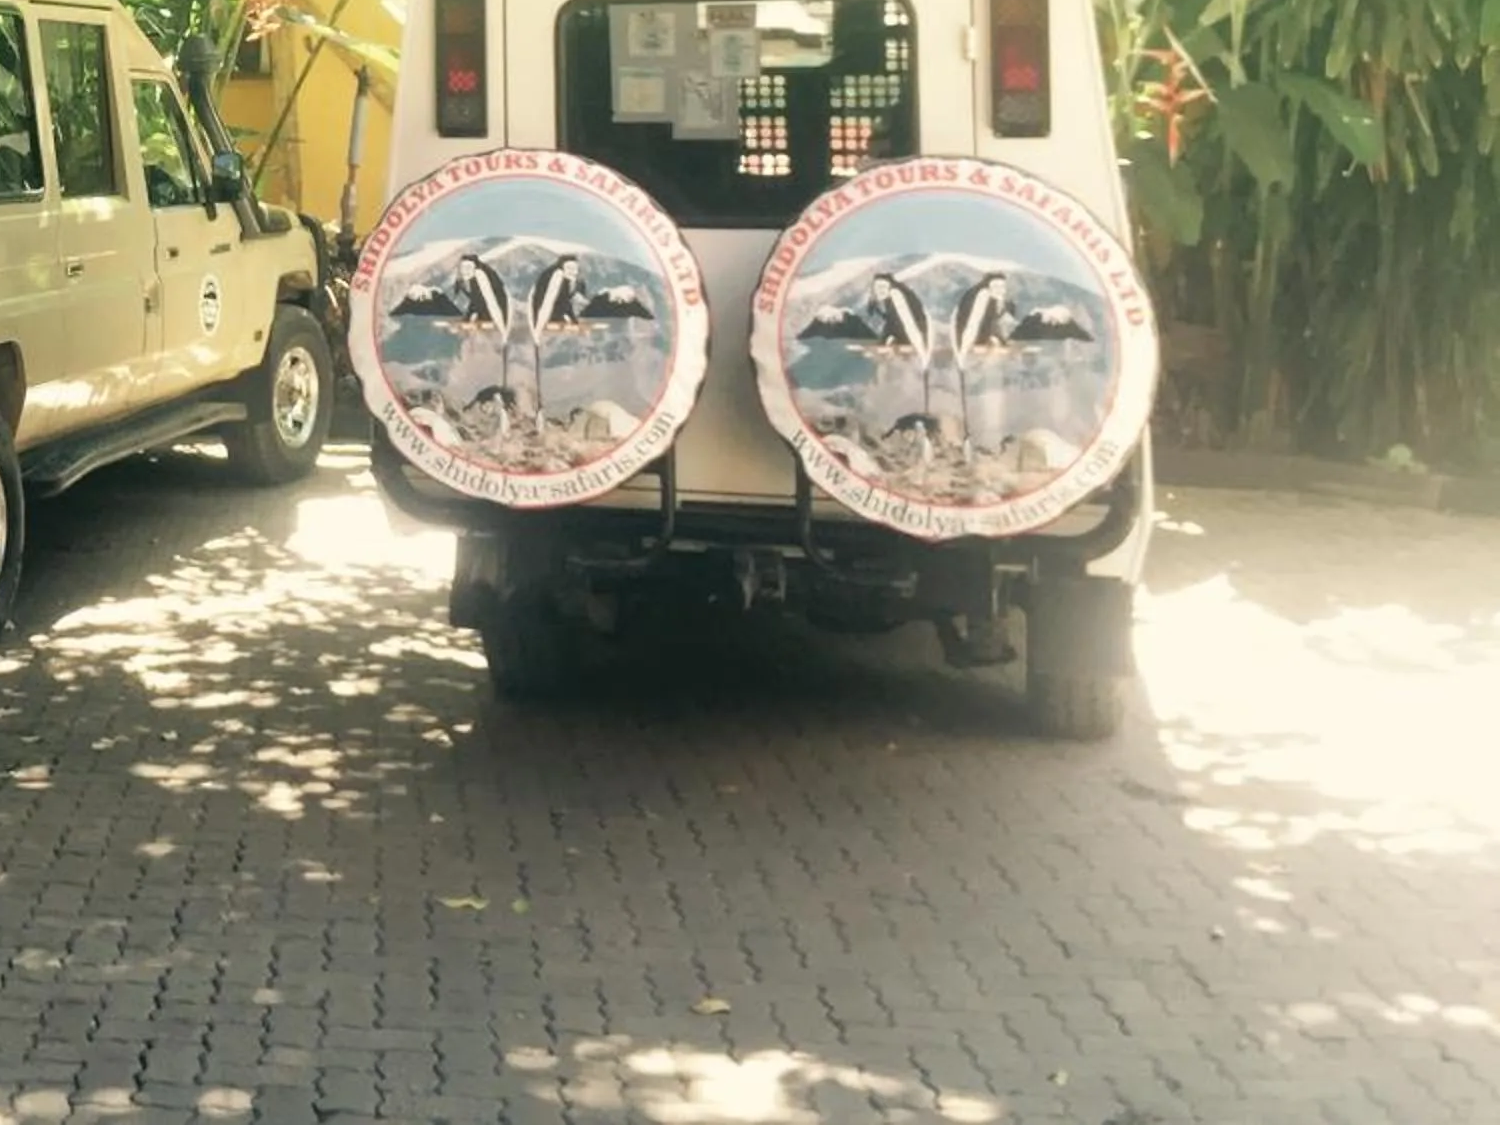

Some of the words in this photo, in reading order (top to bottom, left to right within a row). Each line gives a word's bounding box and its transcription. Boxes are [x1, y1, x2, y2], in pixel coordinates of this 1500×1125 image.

[354, 177, 445, 293] SHIDOLYA
[445, 154, 539, 183] TOURS
[547, 157, 567, 174] &
[574, 164, 672, 247] SAFARIS
[759, 190, 853, 314] SHIDOLYA
[854, 163, 960, 197] TOURS
[968, 167, 991, 187] &
[999, 176, 1111, 265] SAFARIS
